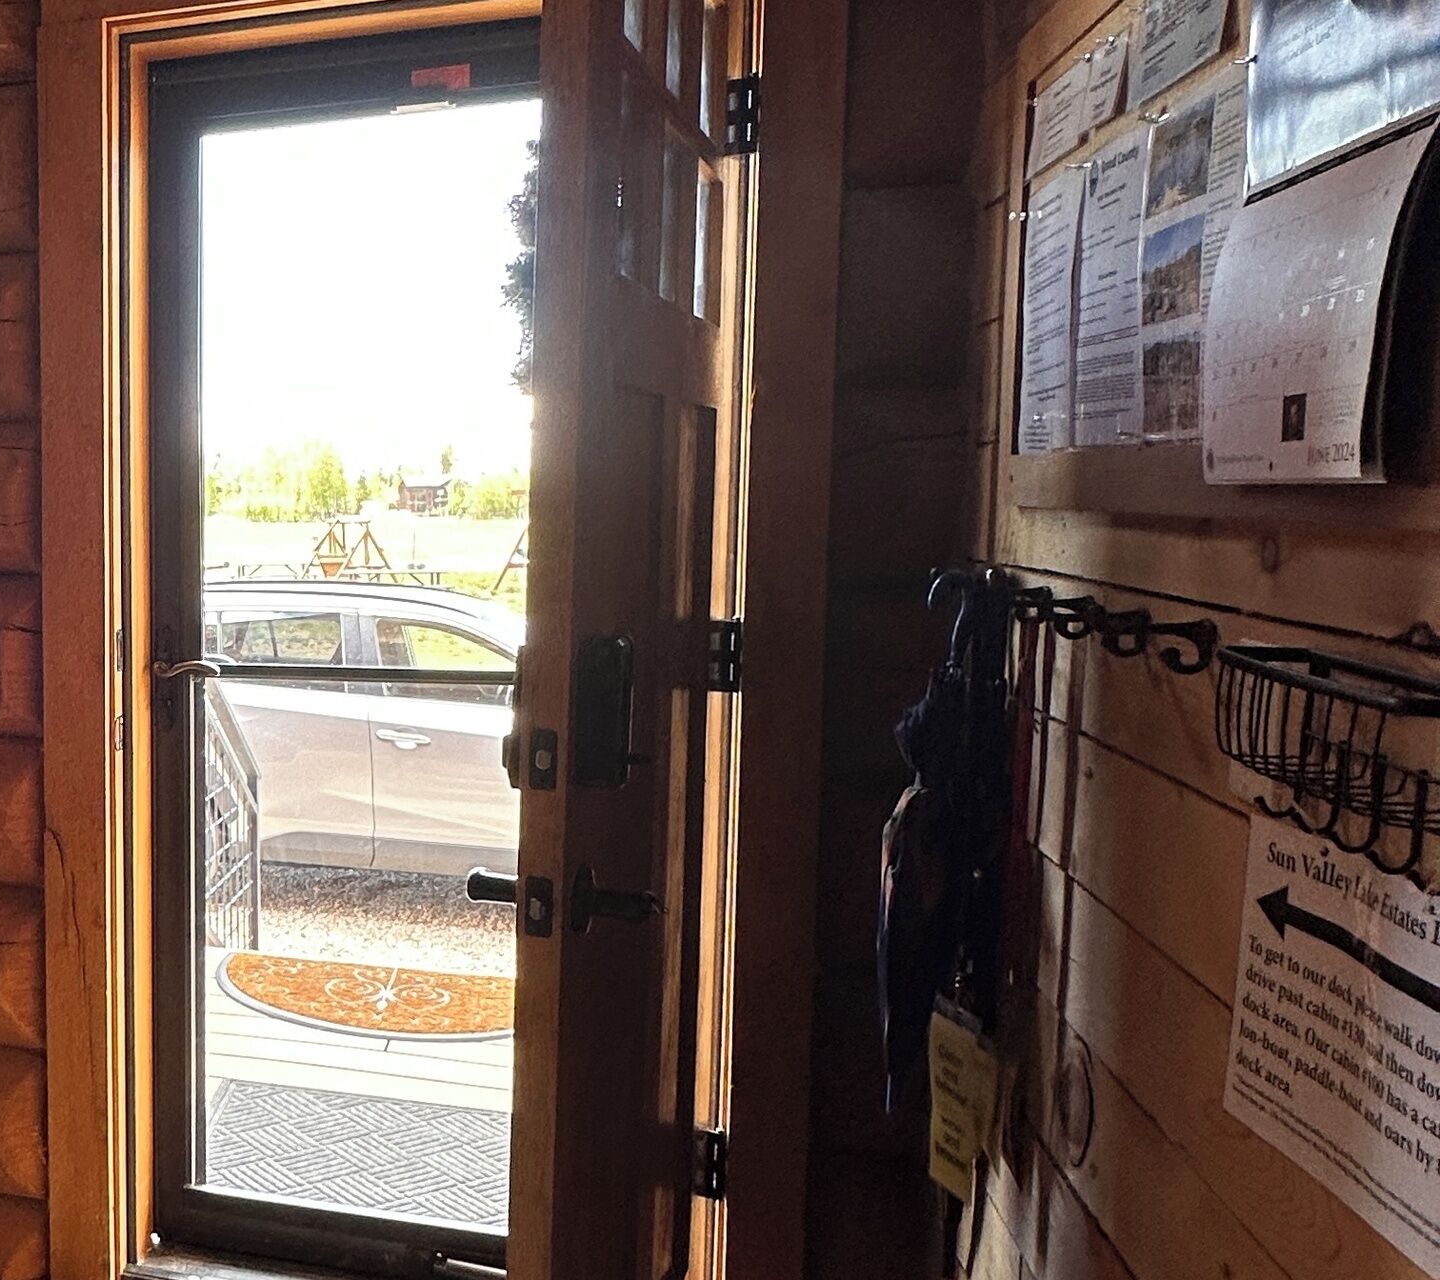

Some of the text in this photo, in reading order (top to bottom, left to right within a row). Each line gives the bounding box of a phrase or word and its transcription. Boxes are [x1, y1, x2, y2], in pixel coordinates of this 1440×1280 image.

[1331, 441, 1355, 462] 2024
[1267, 842, 1296, 873] Sun
[1301, 853, 1353, 900] Valley
[1353, 876, 1379, 912] Lake
[1379, 892, 1427, 940] Estates
[1245, 964, 1277, 993] drive
[1277, 983, 1304, 1010] past
[1306, 1000, 1340, 1032] cabin
[1385, 1051, 1414, 1087] then
[1249, 934, 1263, 957] To
[1263, 948, 1284, 967] get
[1287, 956, 1300, 974] to
[1302, 967, 1326, 988] our
[1328, 975, 1353, 1007] dock
[1383, 1020, 1413, 1050] walk
[1235, 1047, 1294, 1099] dock area.
[1238, 1019, 1292, 1068] Jon-boat,
[1293, 1056, 1363, 1116] paddle-boat
[1364, 1107, 1382, 1133] and
[1385, 1124, 1412, 1155] oars
[1416, 1139, 1434, 1173] by
[1242, 992, 1270, 1021] dock
[1272, 1012, 1301, 1040] area.
[1305, 1027, 1330, 1056] Our
[1331, 1043, 1360, 1079] cabin
[1386, 1085, 1408, 1117] has
[1410, 1108, 1419, 1125] a
